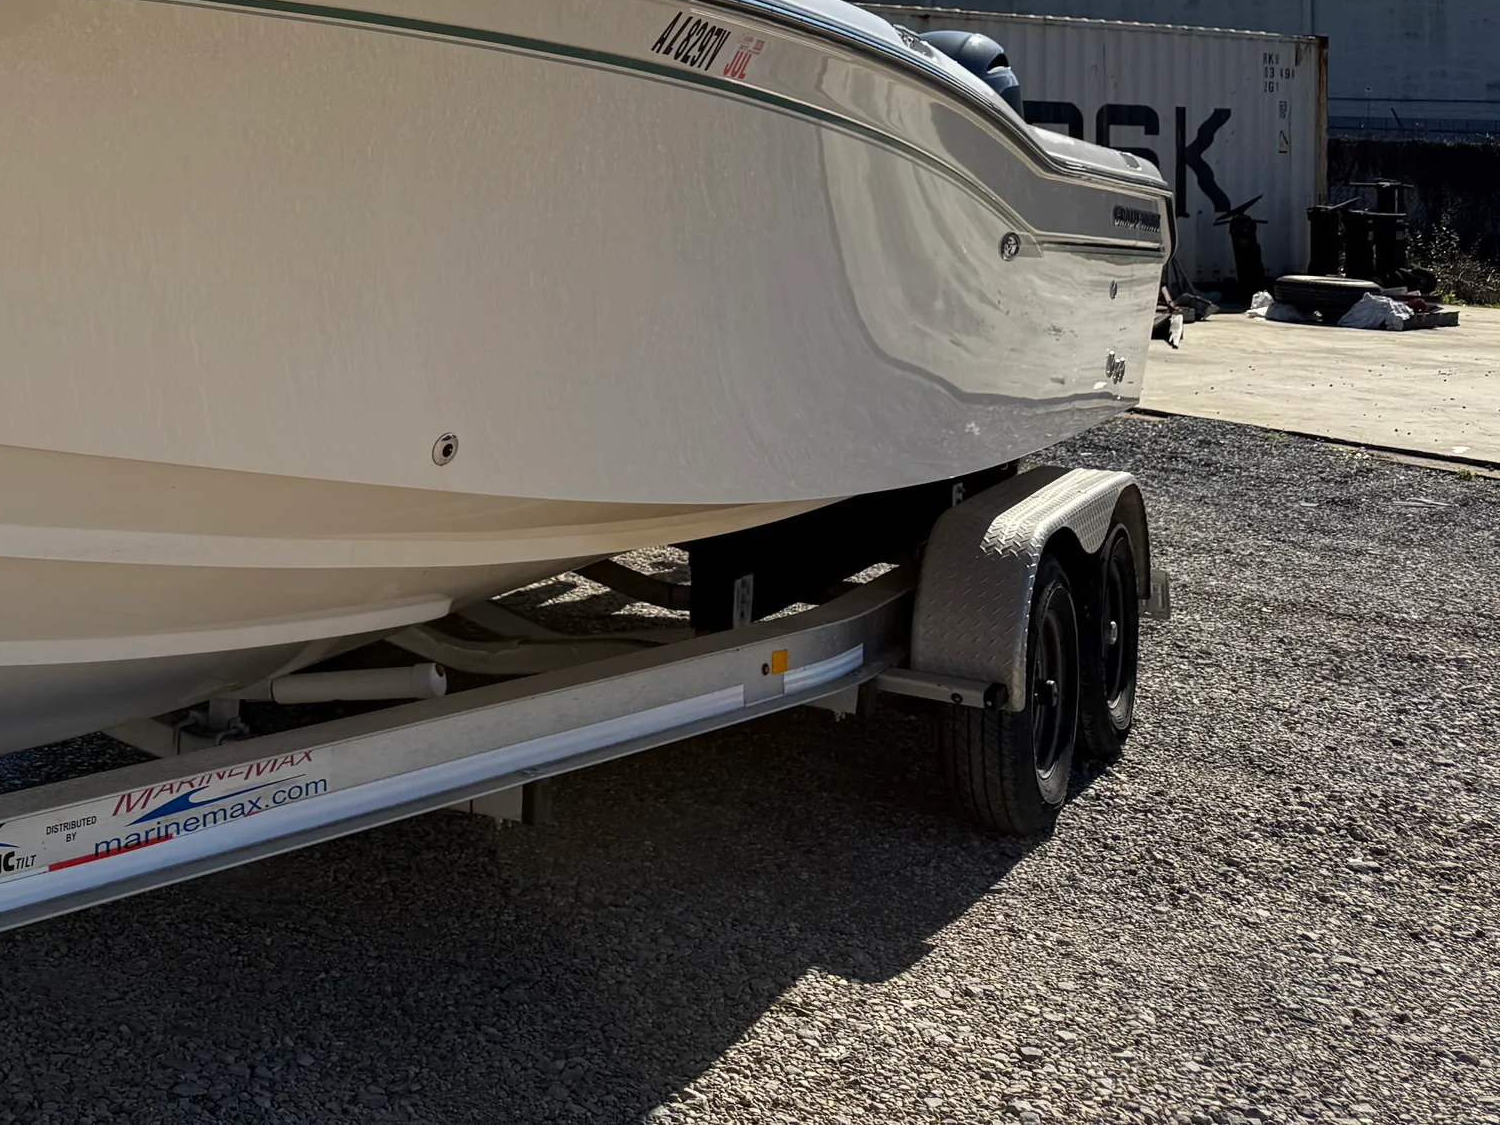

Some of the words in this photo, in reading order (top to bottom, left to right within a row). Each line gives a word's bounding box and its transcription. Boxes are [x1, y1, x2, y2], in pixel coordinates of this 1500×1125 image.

[46, 815, 97, 835] DISTRIBUTED
[95, 778, 328, 858] marinemax.com
[65, 832, 77, 843] BY
